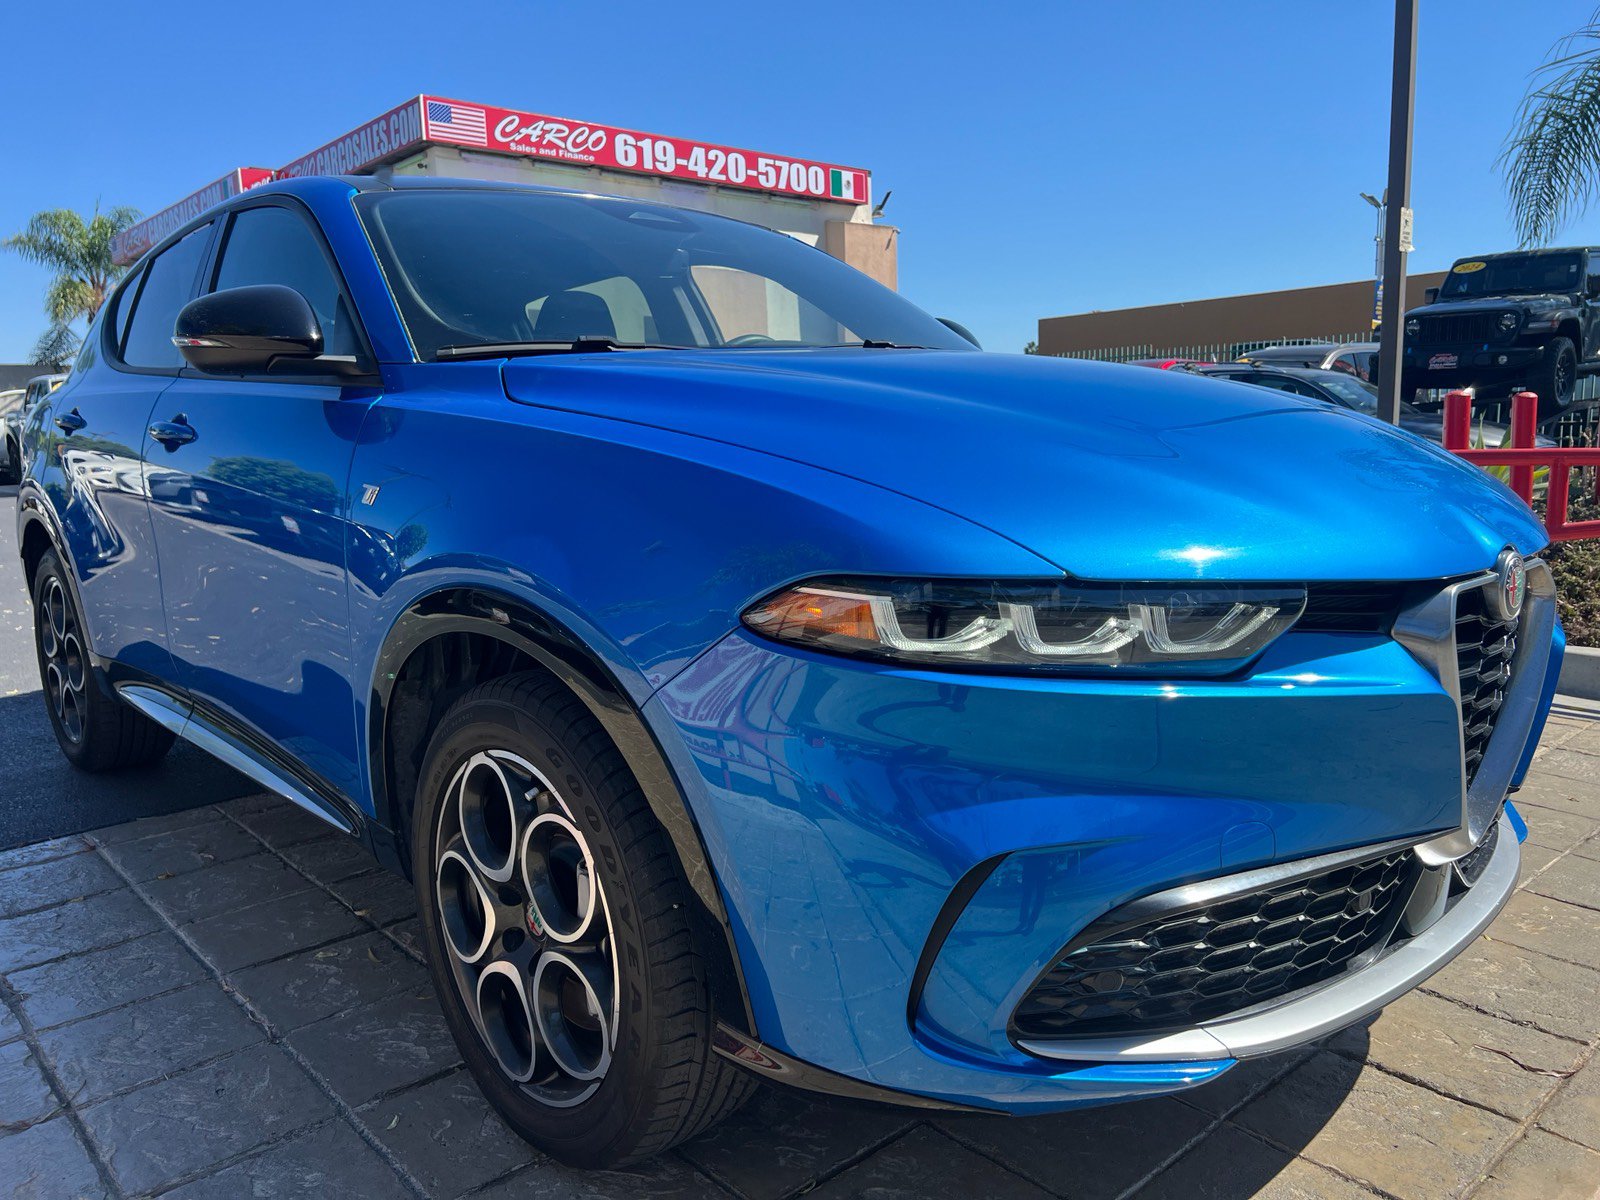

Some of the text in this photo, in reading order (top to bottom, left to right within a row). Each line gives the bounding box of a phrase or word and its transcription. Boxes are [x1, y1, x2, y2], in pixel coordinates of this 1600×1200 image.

[315, 102, 421, 175] CARCOSALES.COM
[493, 114, 606, 155] CARCO
[509, 142, 595, 162] Sales and Finance
[614, 133, 825, 195] 619-420-5700
[147, 184, 222, 243] CARCOSALESCOM
